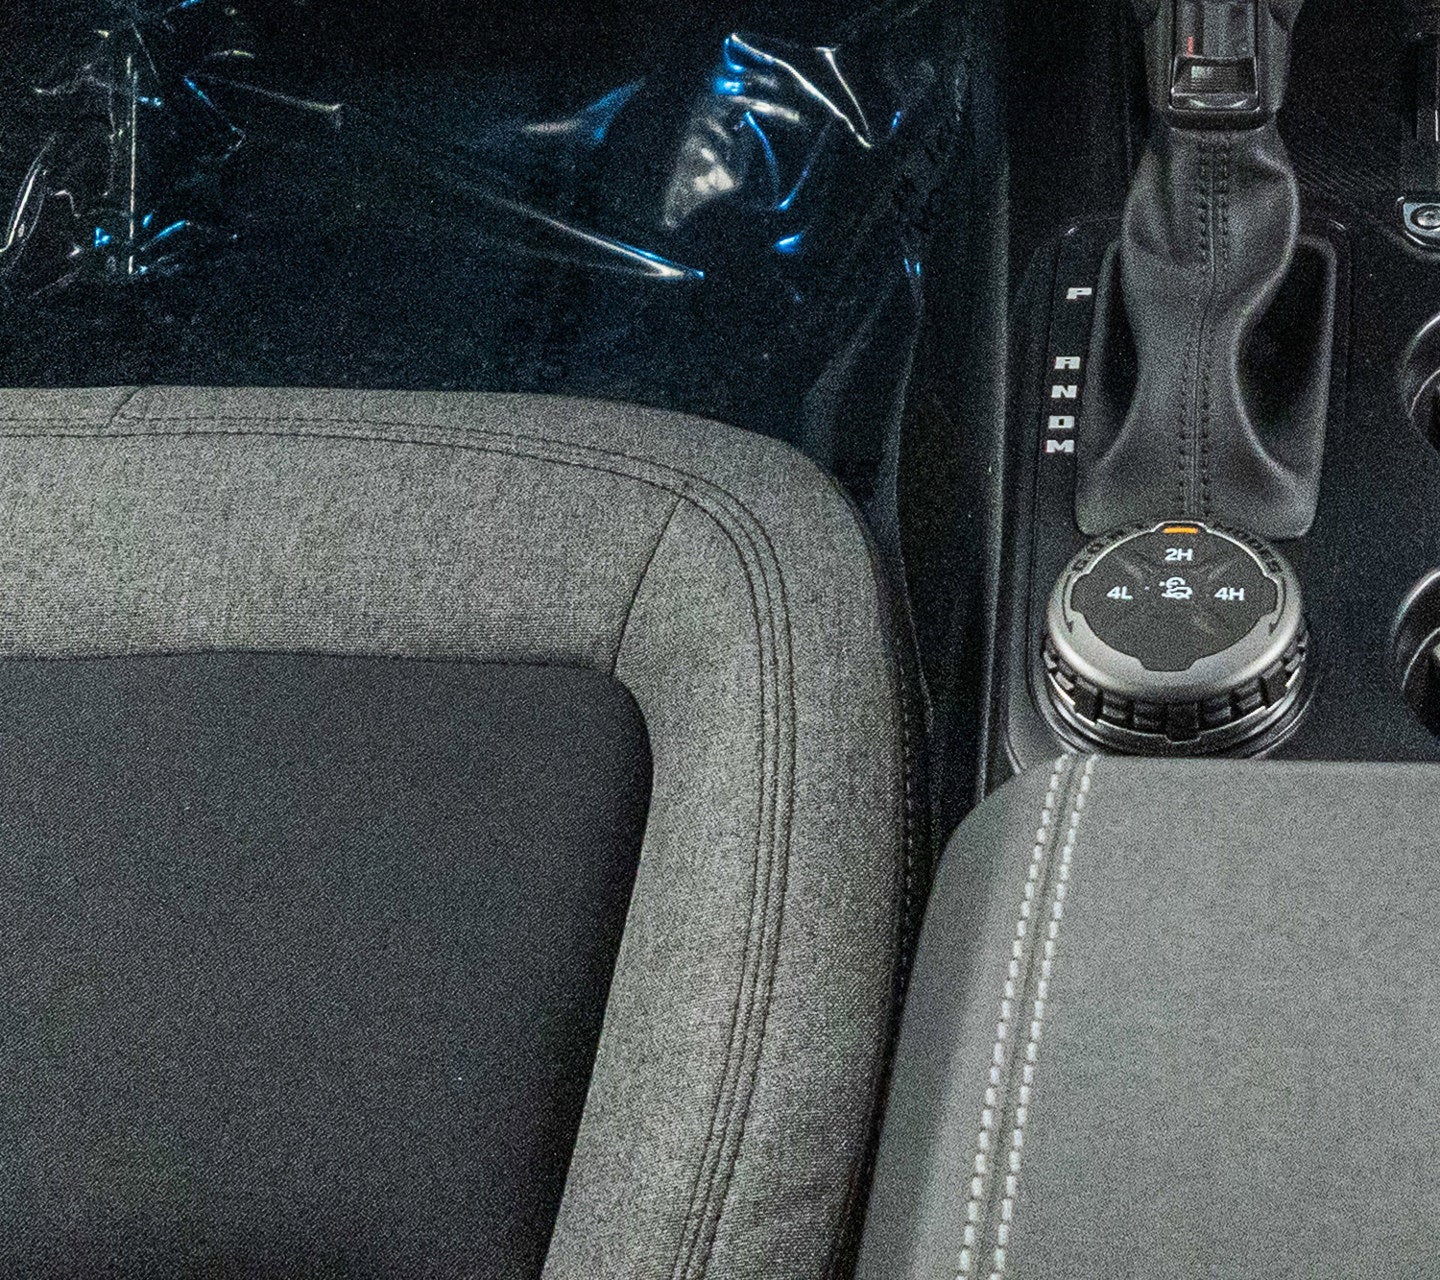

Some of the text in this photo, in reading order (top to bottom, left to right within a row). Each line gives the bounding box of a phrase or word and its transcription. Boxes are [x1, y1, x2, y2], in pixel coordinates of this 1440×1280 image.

[1066, 287, 1092, 300] P
[1051, 384, 1078, 399] N
[1046, 439, 1075, 454] M
[1164, 548, 1194, 562] 2H
[1106, 586, 1134, 601] 4L
[1214, 587, 1245, 602] 4H
